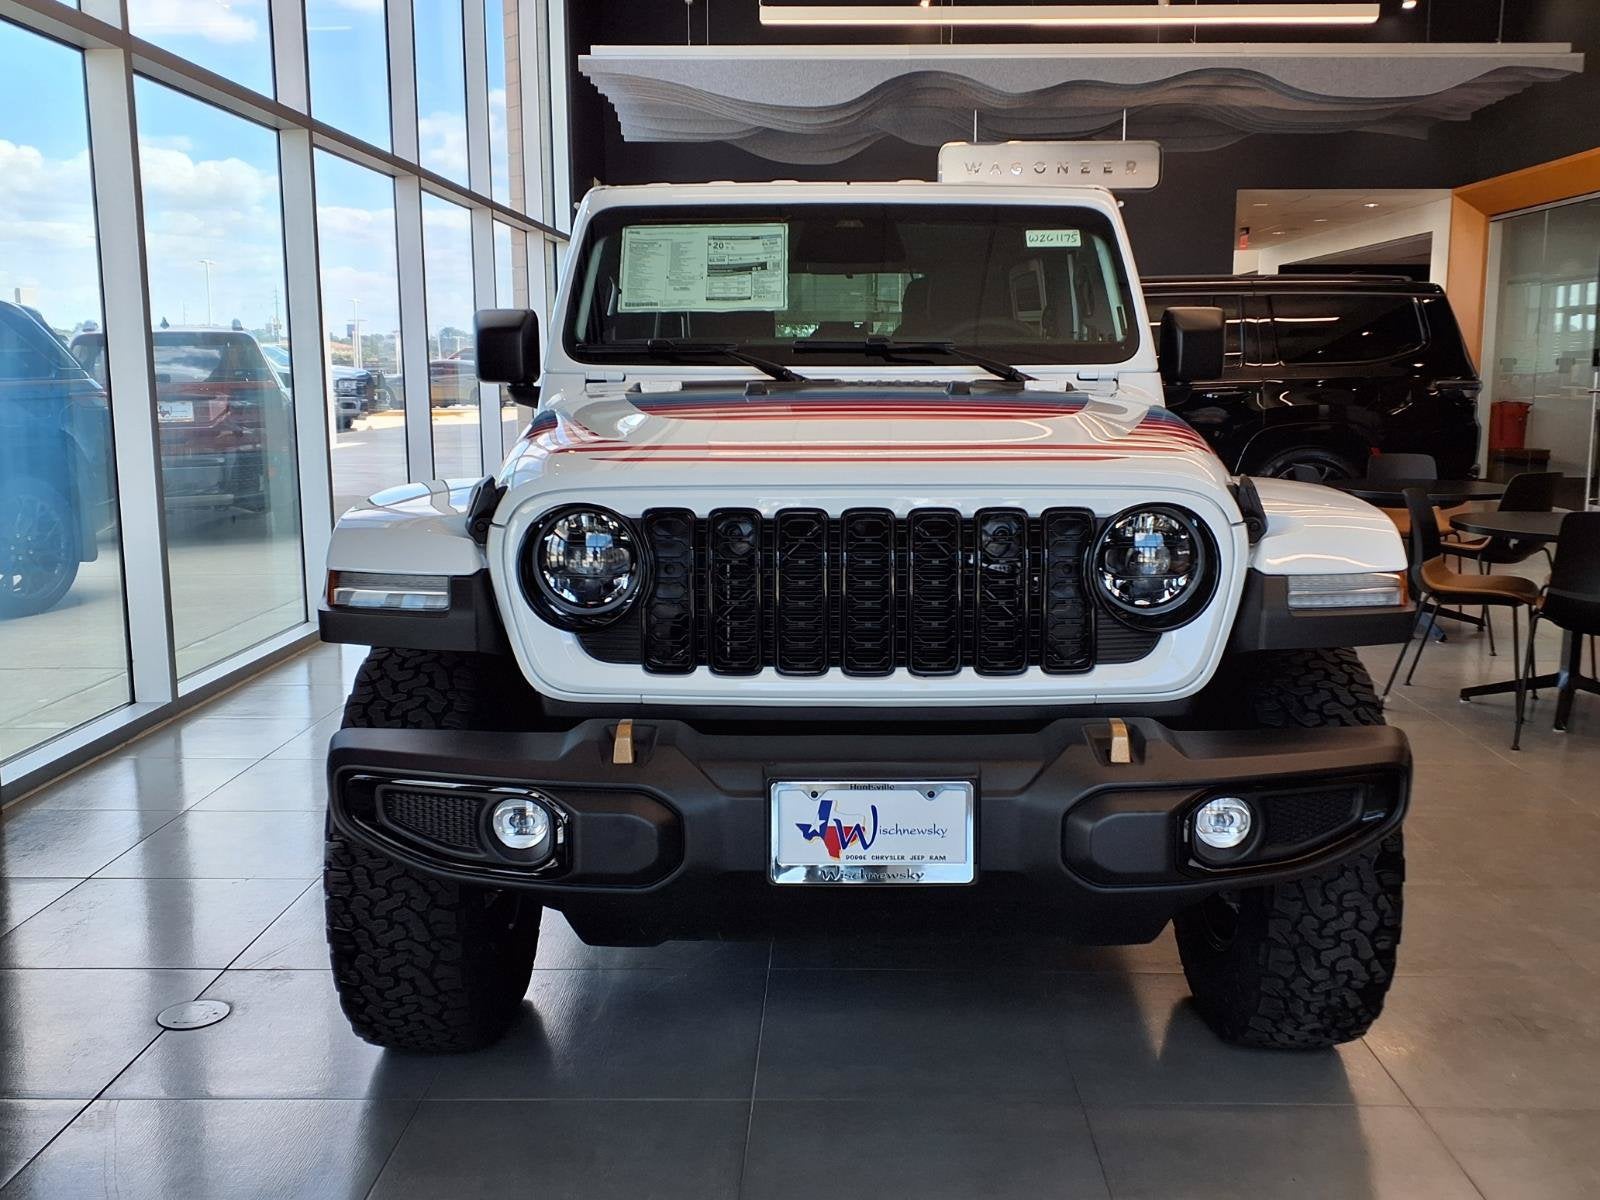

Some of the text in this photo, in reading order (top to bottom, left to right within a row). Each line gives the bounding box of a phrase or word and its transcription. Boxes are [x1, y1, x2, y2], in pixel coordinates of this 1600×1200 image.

[964, 161, 1137, 175] WAGONEER
[712, 241, 724, 250] 20
[833, 804, 948, 850] Wischnewsky
[821, 867, 925, 882] Wischnewsky
